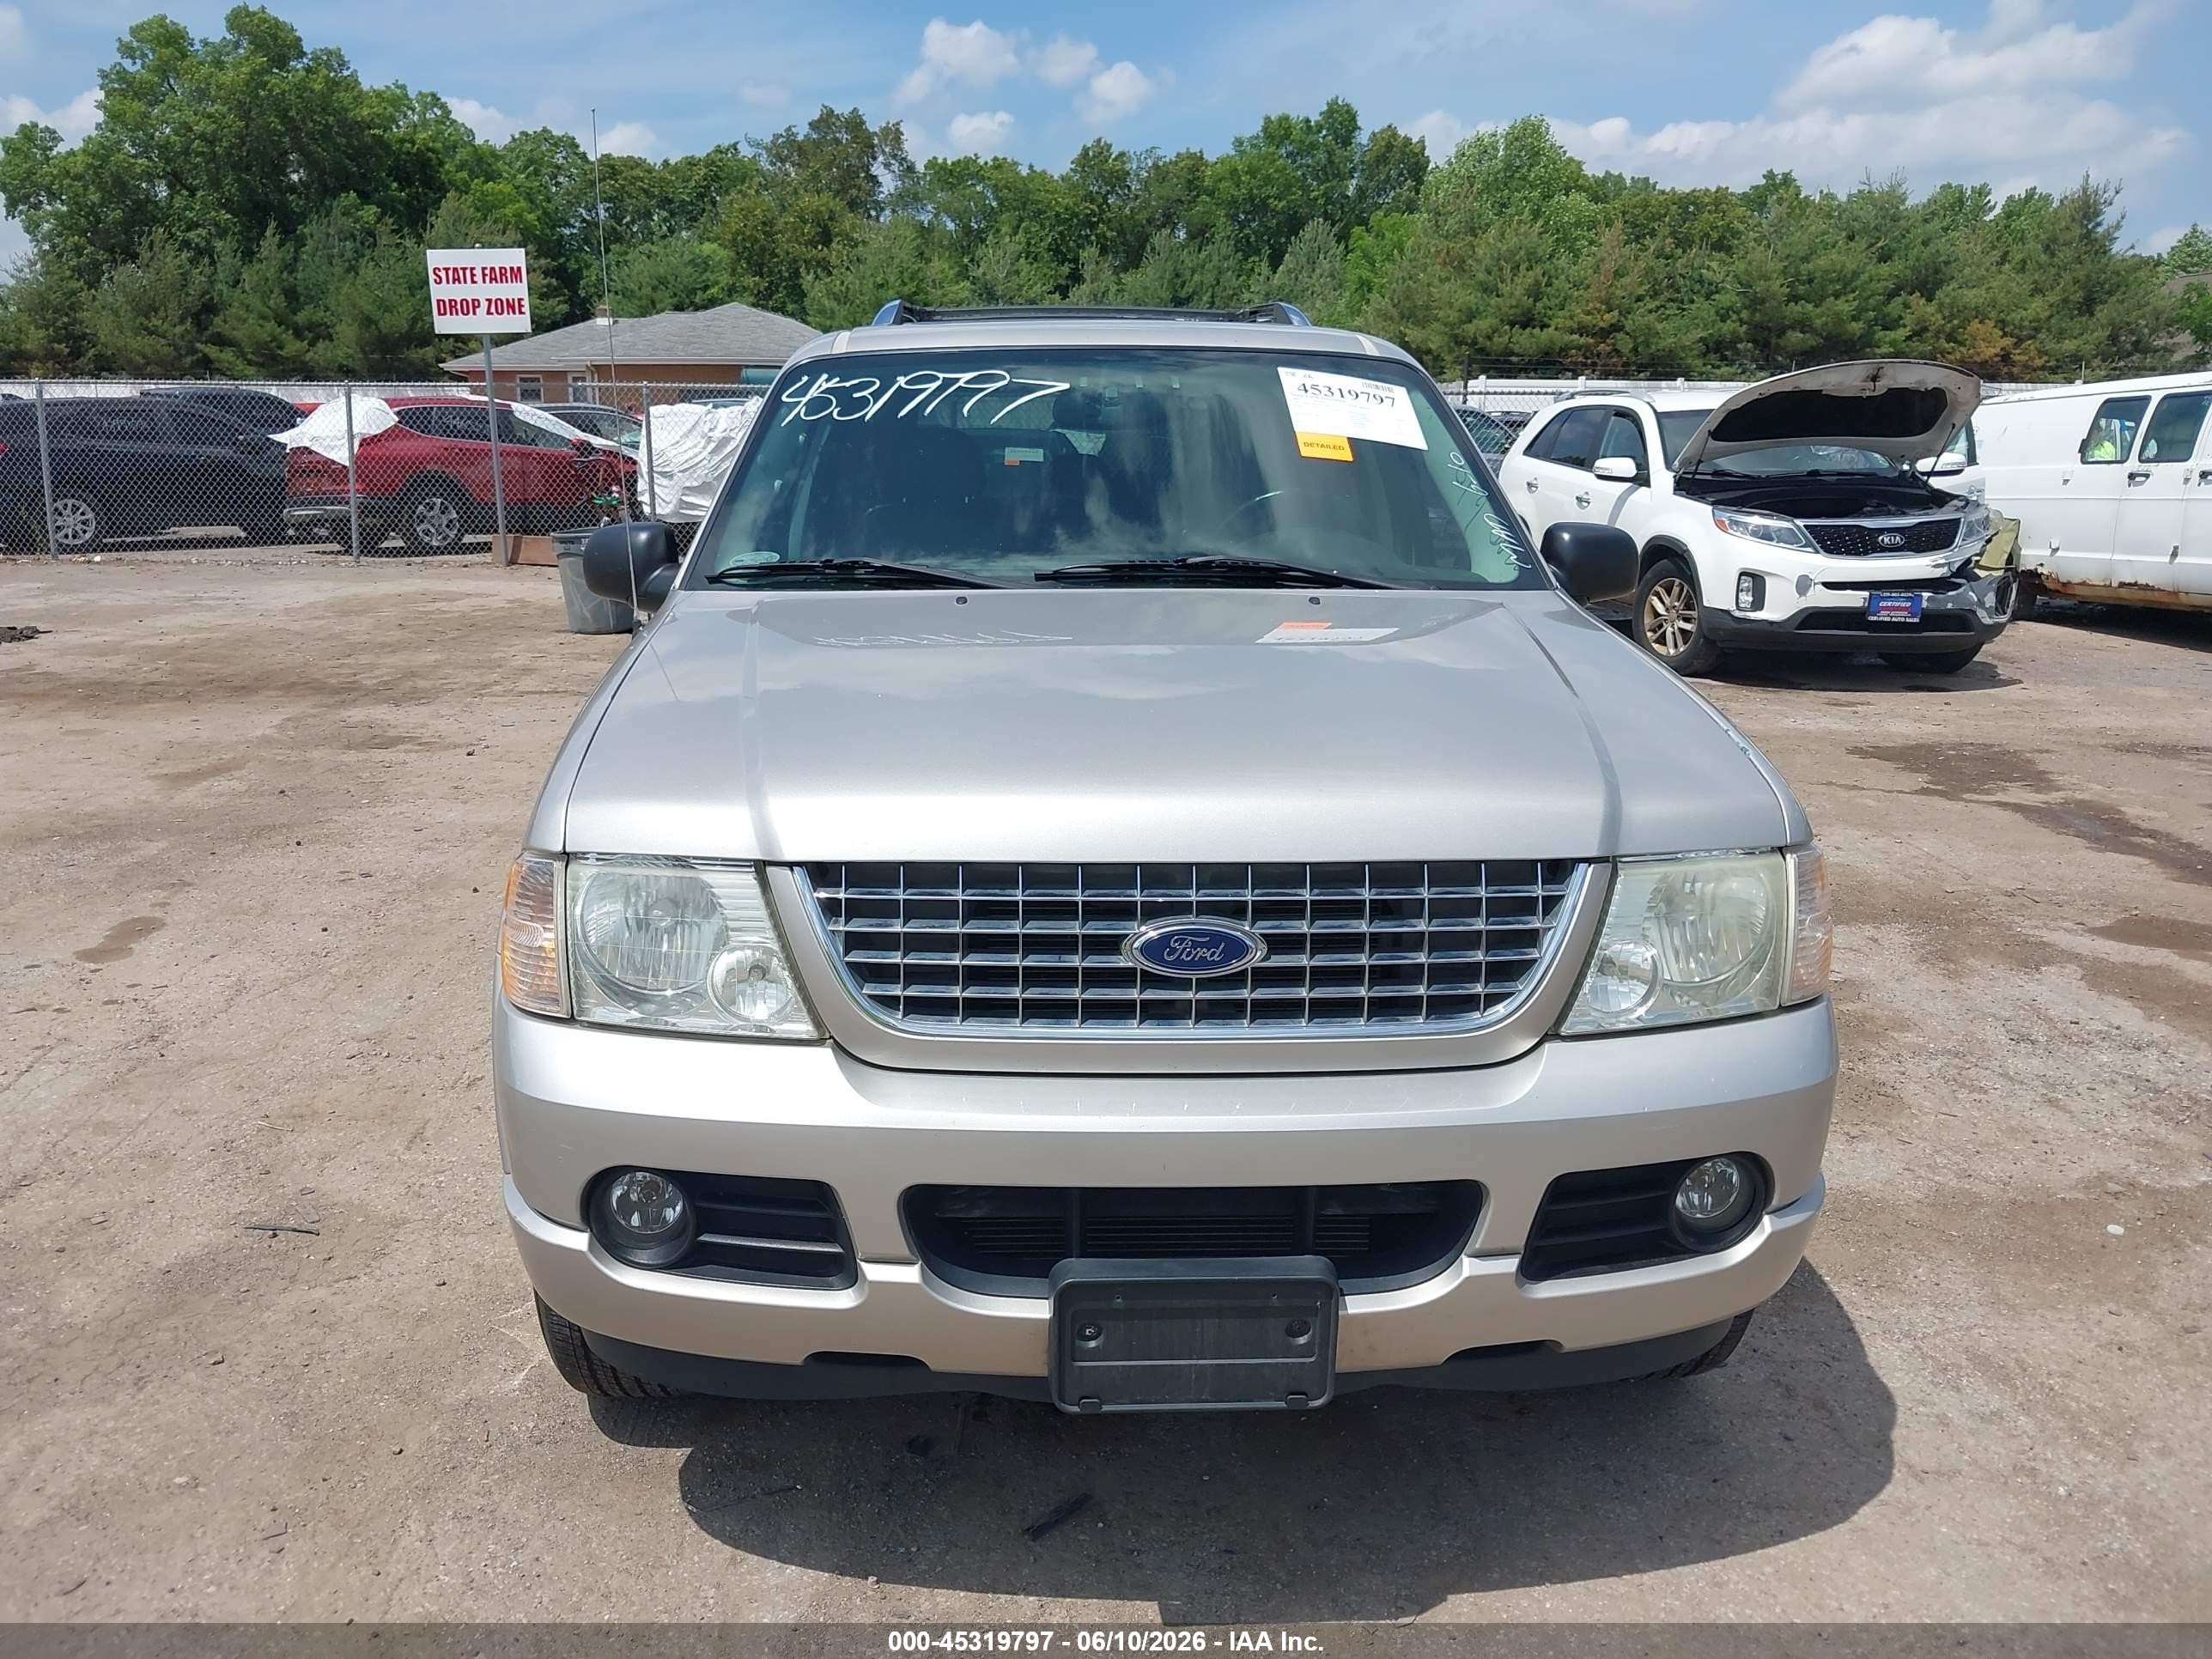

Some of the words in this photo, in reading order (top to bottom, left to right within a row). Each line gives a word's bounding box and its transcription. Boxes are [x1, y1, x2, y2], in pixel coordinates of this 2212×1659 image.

[432, 266, 478, 285] STATE
[480, 265, 524, 284] FARM
[435, 297, 482, 317] DROP
[484, 297, 526, 316] ZONE
[781, 369, 1072, 428] 45319797
[1297, 382, 1396, 409] 45319797
[1303, 441, 1346, 452] DETAILED
[1883, 535, 1901, 545] KIA
[1163, 934, 1226, 963] Ford
